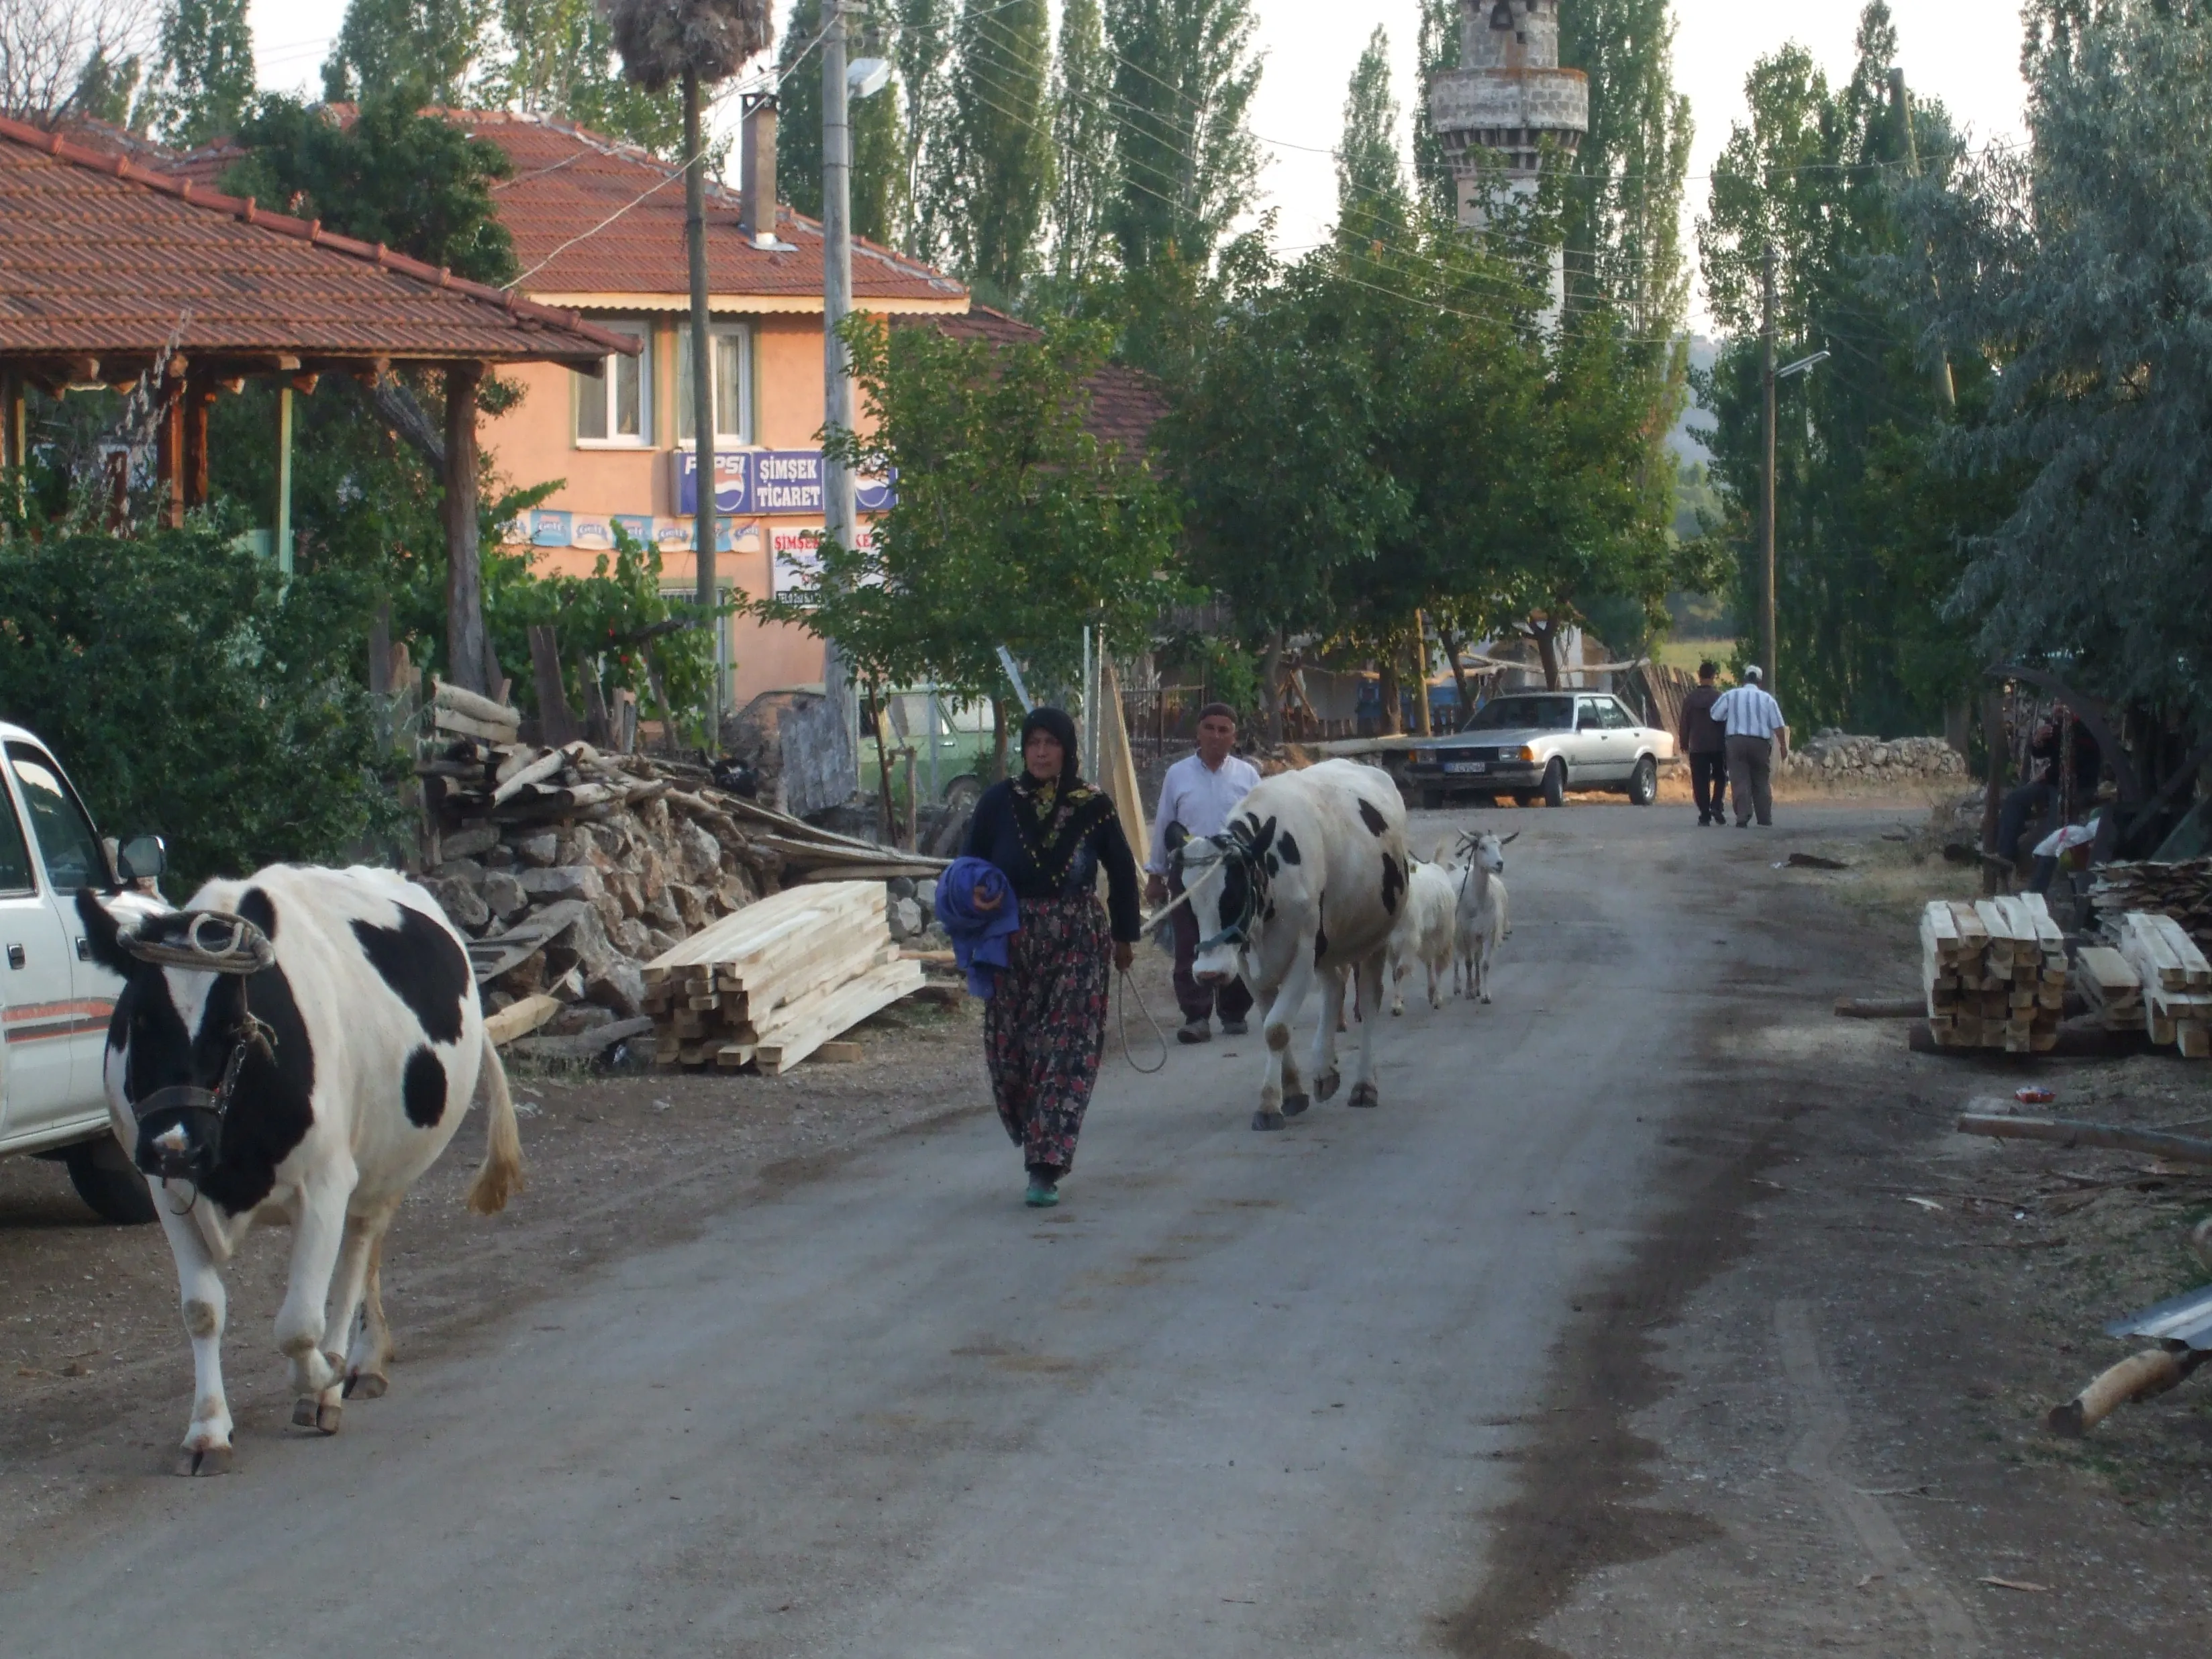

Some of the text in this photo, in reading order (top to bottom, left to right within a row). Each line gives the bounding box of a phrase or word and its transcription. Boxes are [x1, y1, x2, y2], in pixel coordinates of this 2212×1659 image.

[685, 456, 746, 475] PPSI
[760, 456, 817, 483] ŞİMŞEK
[757, 483, 821, 507] TİCARET
